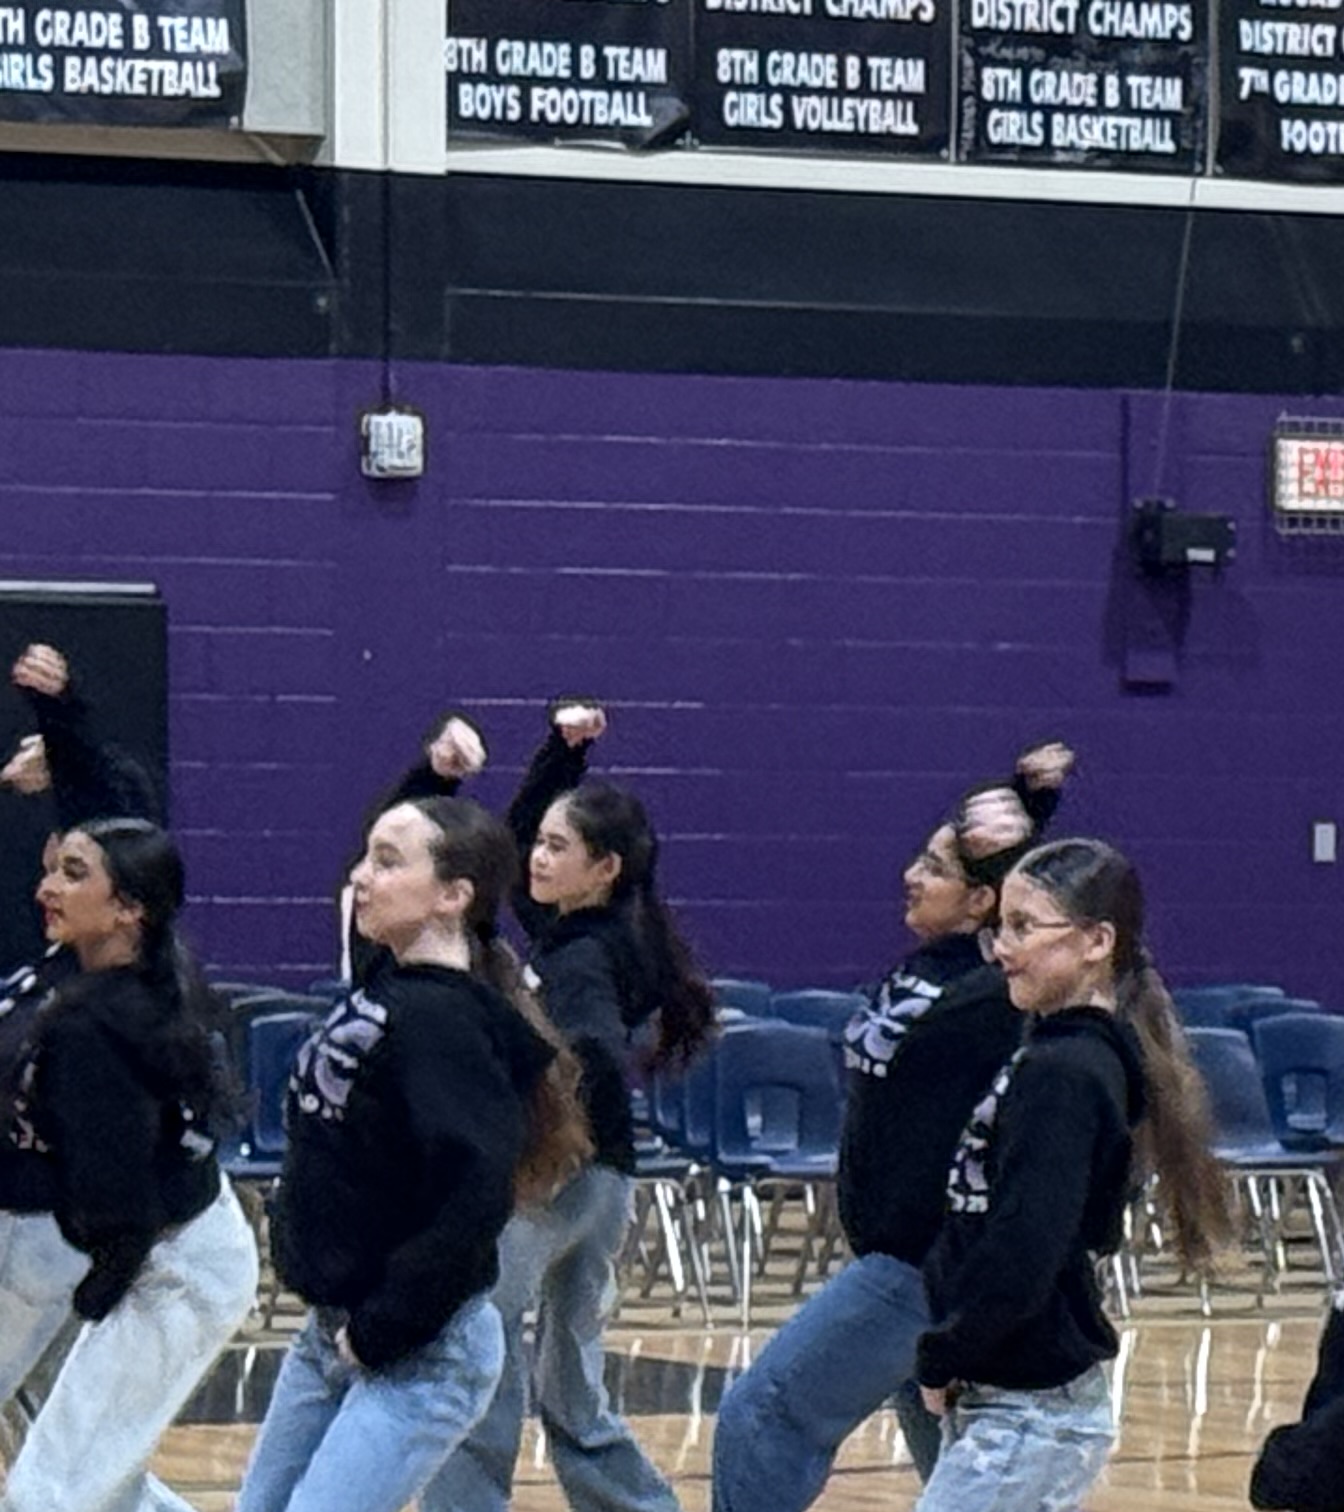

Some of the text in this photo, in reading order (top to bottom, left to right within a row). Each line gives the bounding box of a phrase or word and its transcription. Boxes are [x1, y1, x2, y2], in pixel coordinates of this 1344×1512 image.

[35, 9, 124, 49] GRADE
[133, 14, 149, 50] B
[157, 15, 229, 54] TEAM
[971, 0, 1193, 41] DISTRICT CHAMPS
[1239, 19, 1336, 56] DISTRICT
[0, 53, 221, 97] IRLS BASKETBALL
[496, 39, 572, 79] GRADE
[580, 44, 595, 80] B
[603, 46, 667, 83] TEAM
[717, 48, 925, 92] 8TH GRADE B TEAM
[458, 83, 653, 127] BOYS FOOTBALL
[981, 67, 1182, 111] 8TH GRADE B TEAM
[723, 92, 918, 134] GIRLS VOLLEYBALL
[987, 109, 1176, 153] GIRLS BASKETBALL
